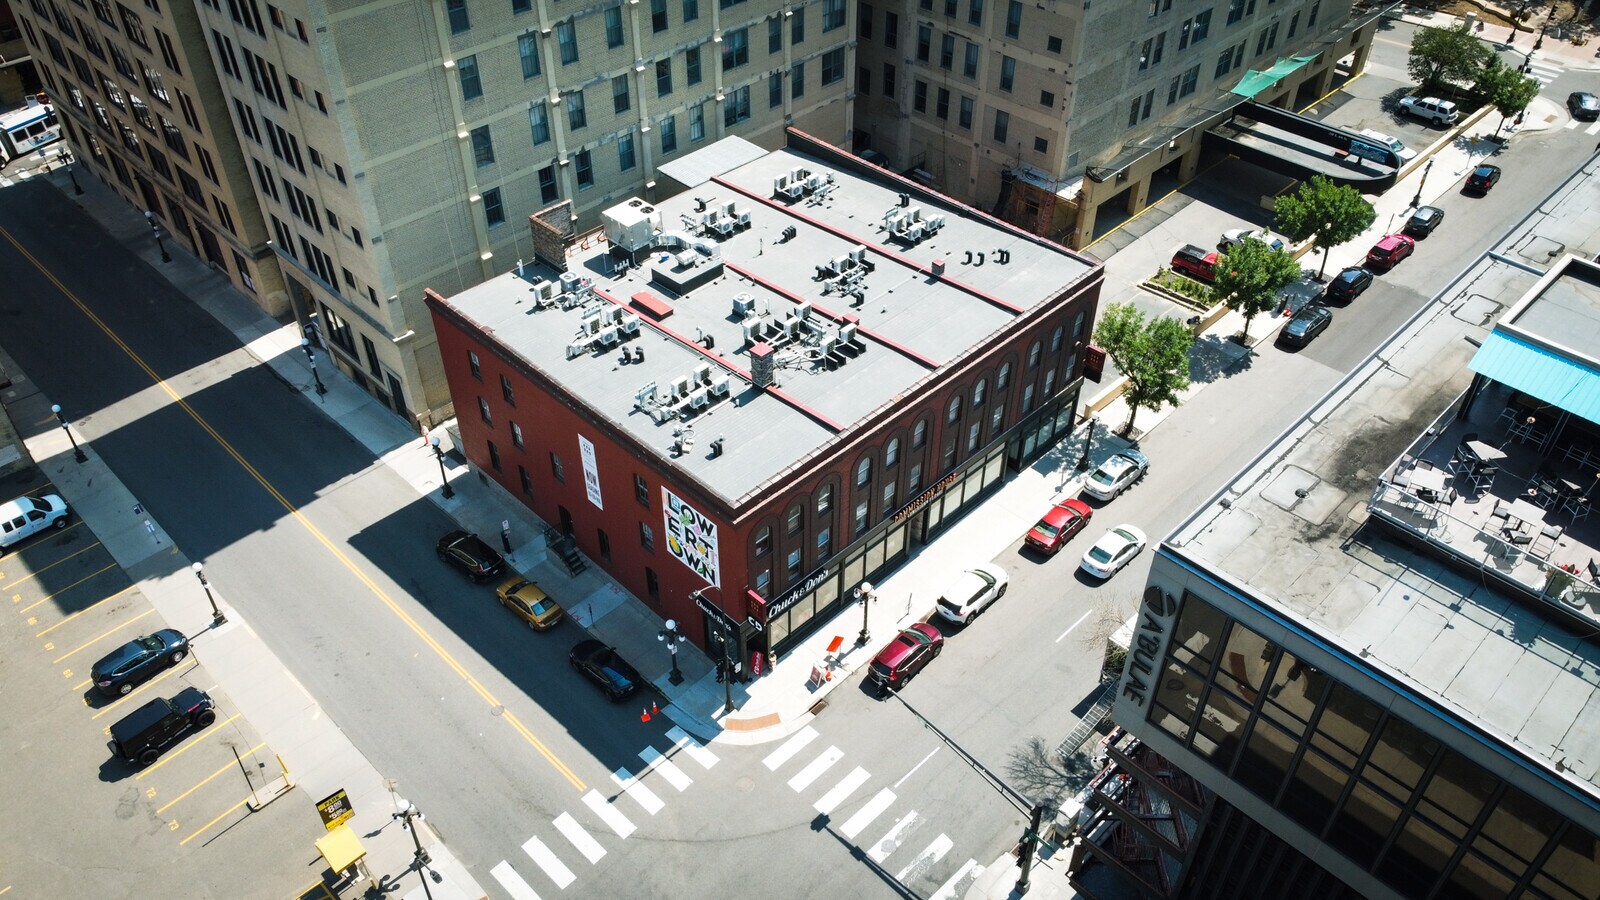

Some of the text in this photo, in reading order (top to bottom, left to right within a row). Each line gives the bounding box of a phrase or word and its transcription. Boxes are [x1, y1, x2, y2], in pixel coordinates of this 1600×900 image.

[768, 589, 800, 619] Chuck
[804, 569, 829, 591] Don's
[747, 616, 763, 632] CD
[145, 786, 158, 799] 72
[324, 795, 341, 807] PARK
[167, 819, 180, 832] 73
